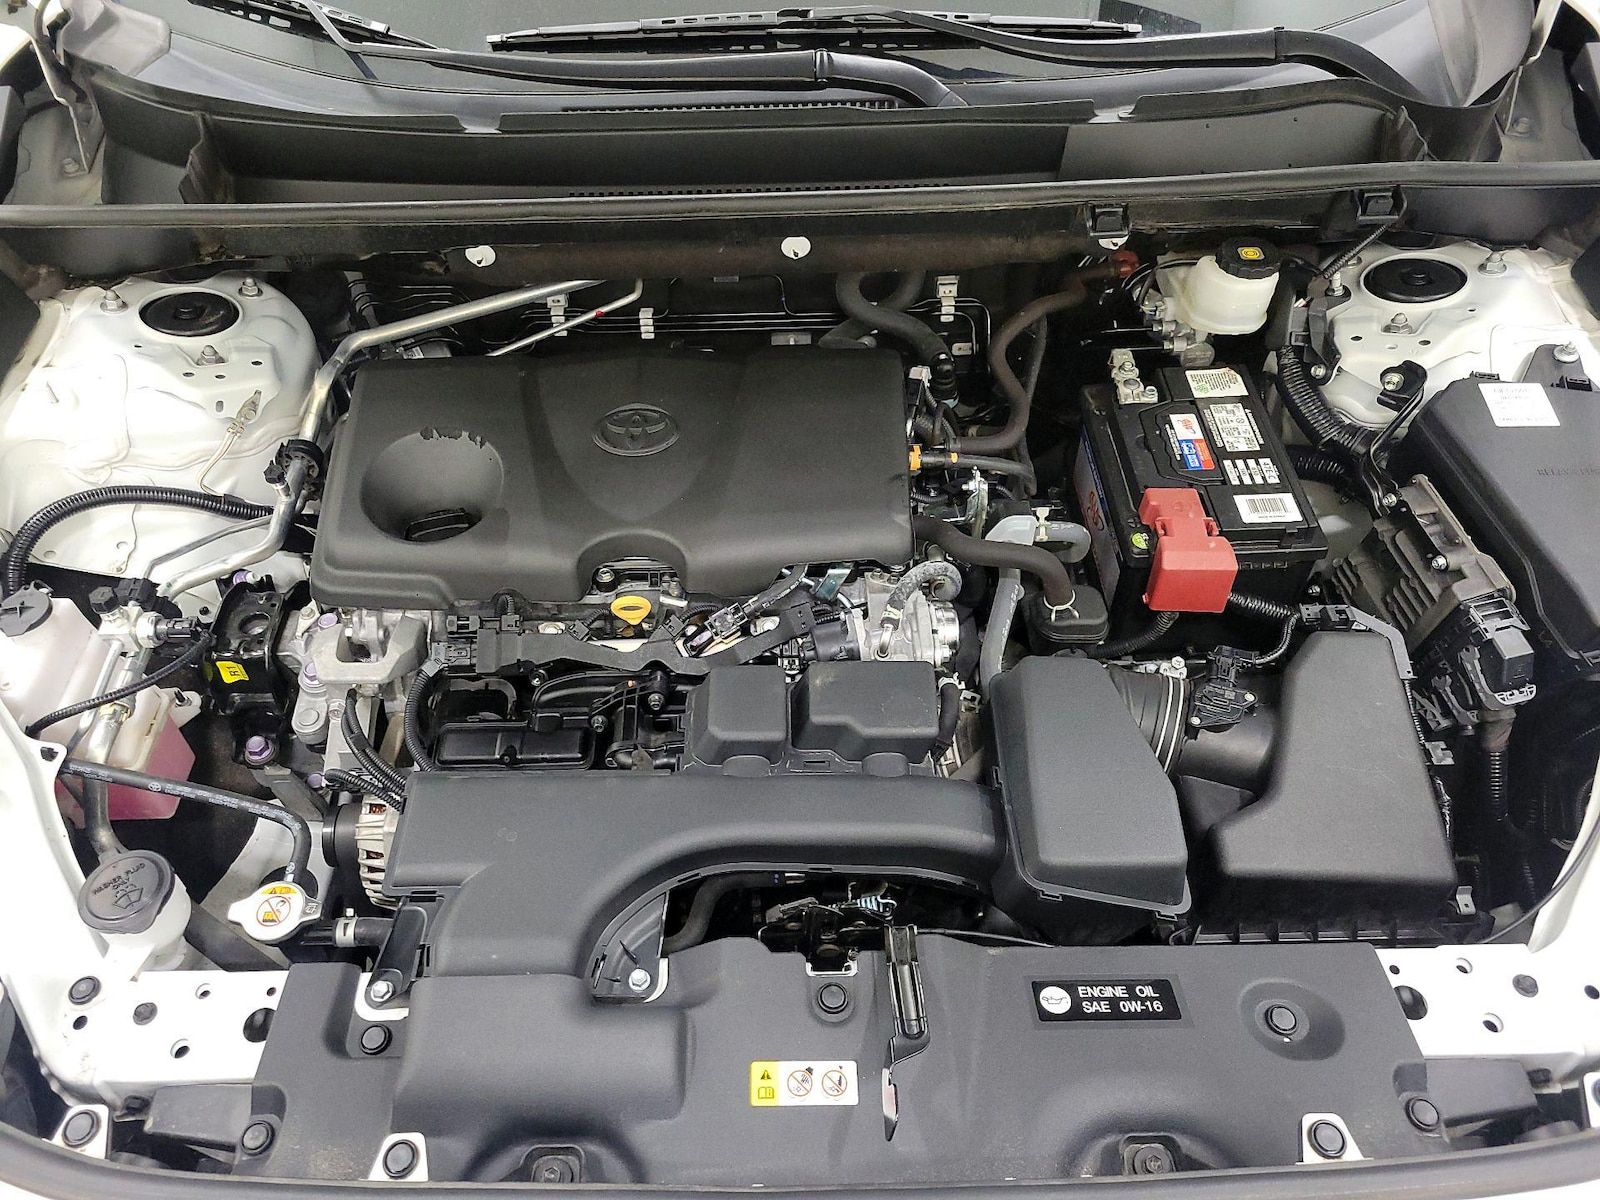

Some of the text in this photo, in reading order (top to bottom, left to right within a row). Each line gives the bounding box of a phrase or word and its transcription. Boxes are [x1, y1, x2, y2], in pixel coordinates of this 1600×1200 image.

[91, 875, 122, 895] WASHER
[1077, 985, 1160, 998] ENGINE OIL
[1082, 1000, 1164, 1014] SAE 0W-16
